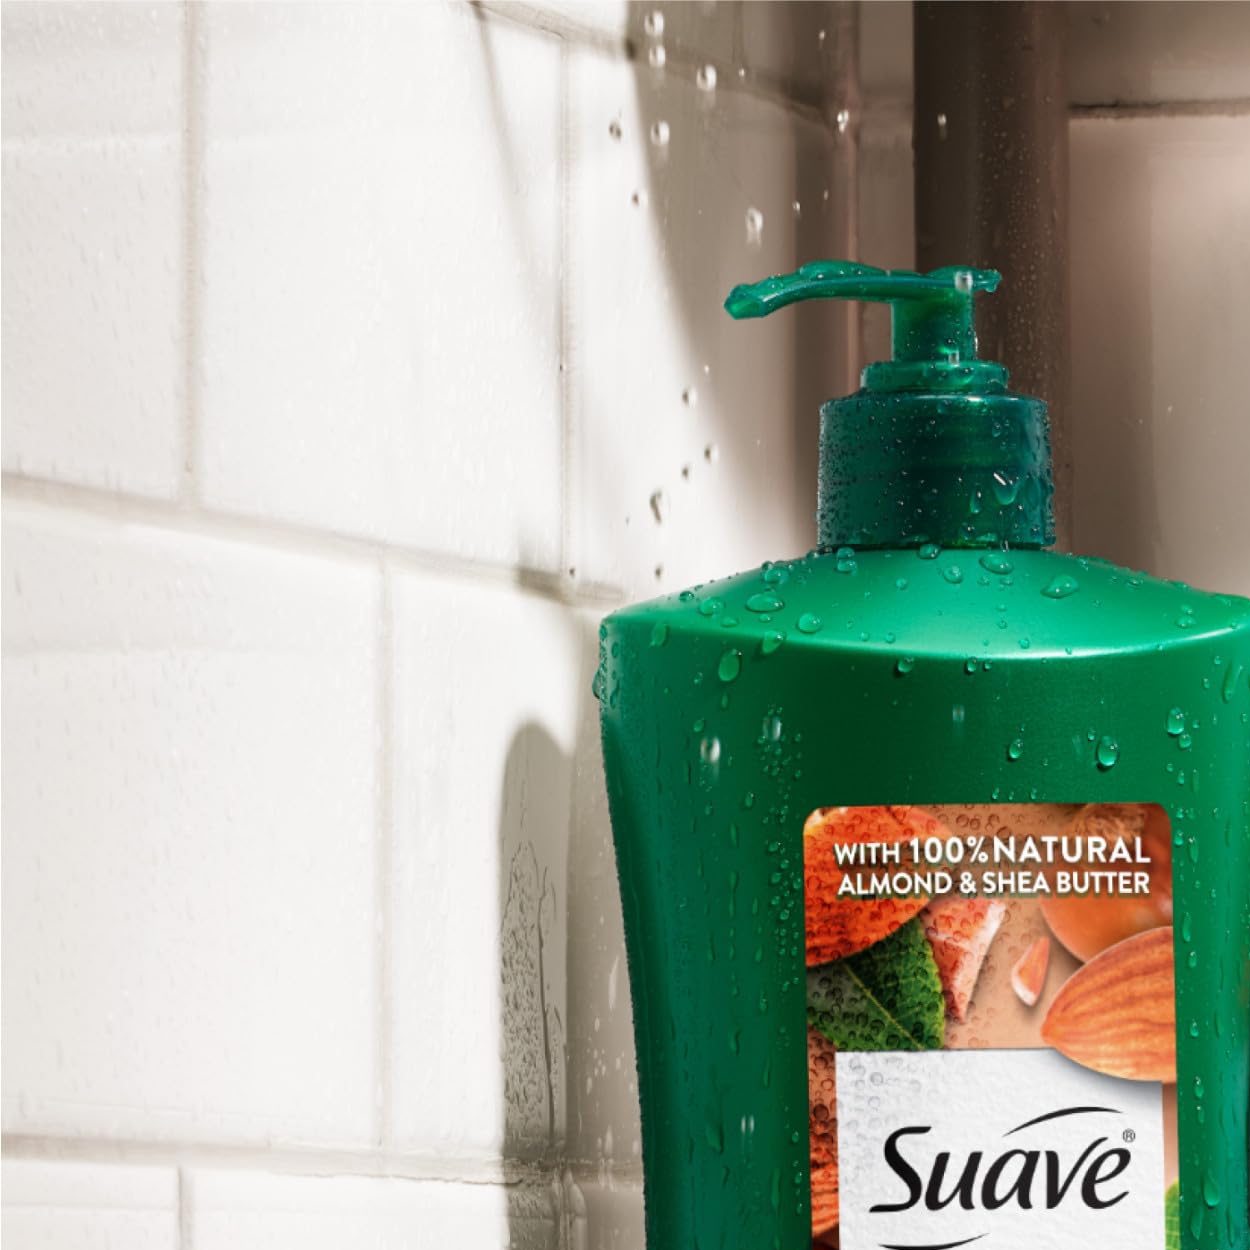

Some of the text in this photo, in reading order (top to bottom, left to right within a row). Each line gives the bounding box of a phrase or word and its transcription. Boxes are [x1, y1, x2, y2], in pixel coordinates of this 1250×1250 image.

[834, 843, 900, 865] WITH
[838, 872, 1150, 895] ALMOND & SHEA BUTTER
